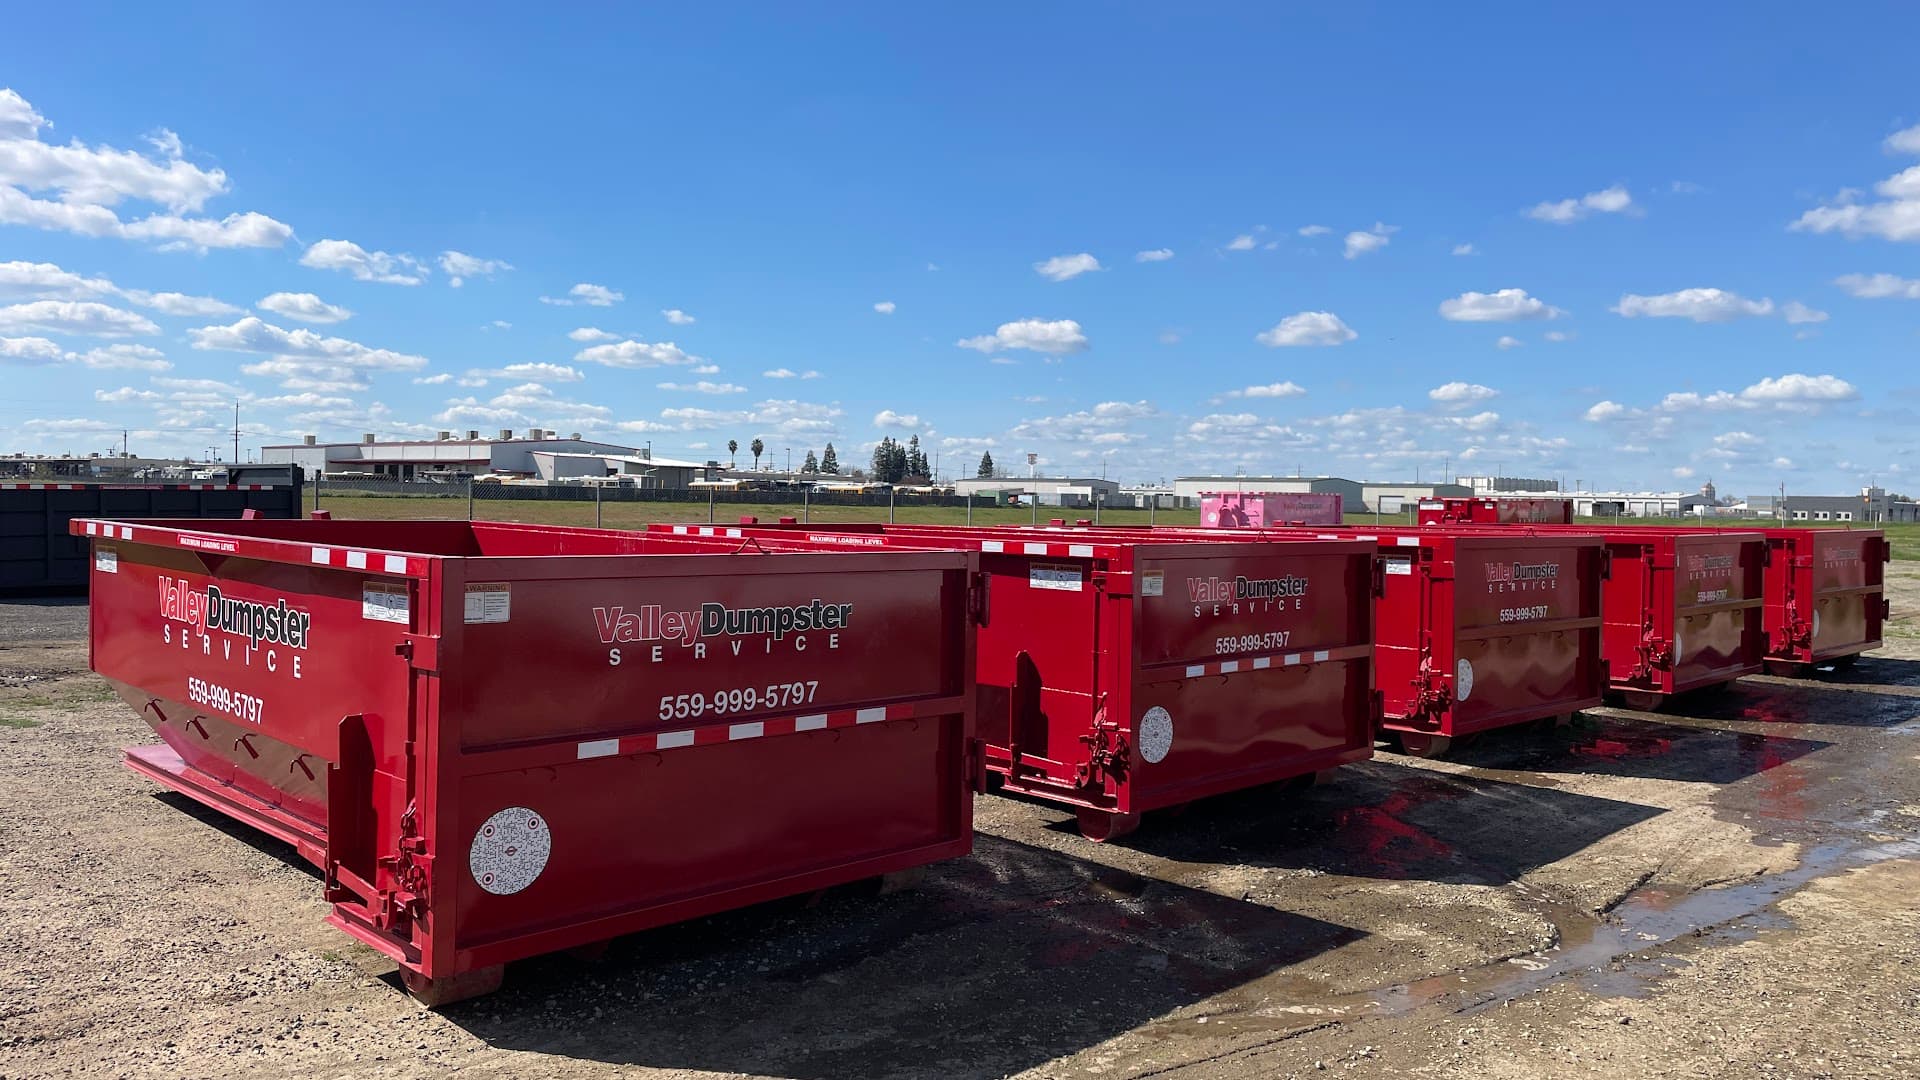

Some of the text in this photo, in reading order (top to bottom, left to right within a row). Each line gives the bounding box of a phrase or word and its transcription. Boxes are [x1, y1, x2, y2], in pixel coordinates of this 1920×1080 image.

[1194, 599, 1301, 618] SERVICE
[1500, 606, 1549, 622] 559-999-5797
[164, 624, 302, 679] SERVICE
[609, 633, 839, 666] SERVICE
[1215, 631, 1290, 655] 559-999-5797
[188, 676, 264, 725] 559-999-5797
[658, 681, 819, 721] 559-999-5797
